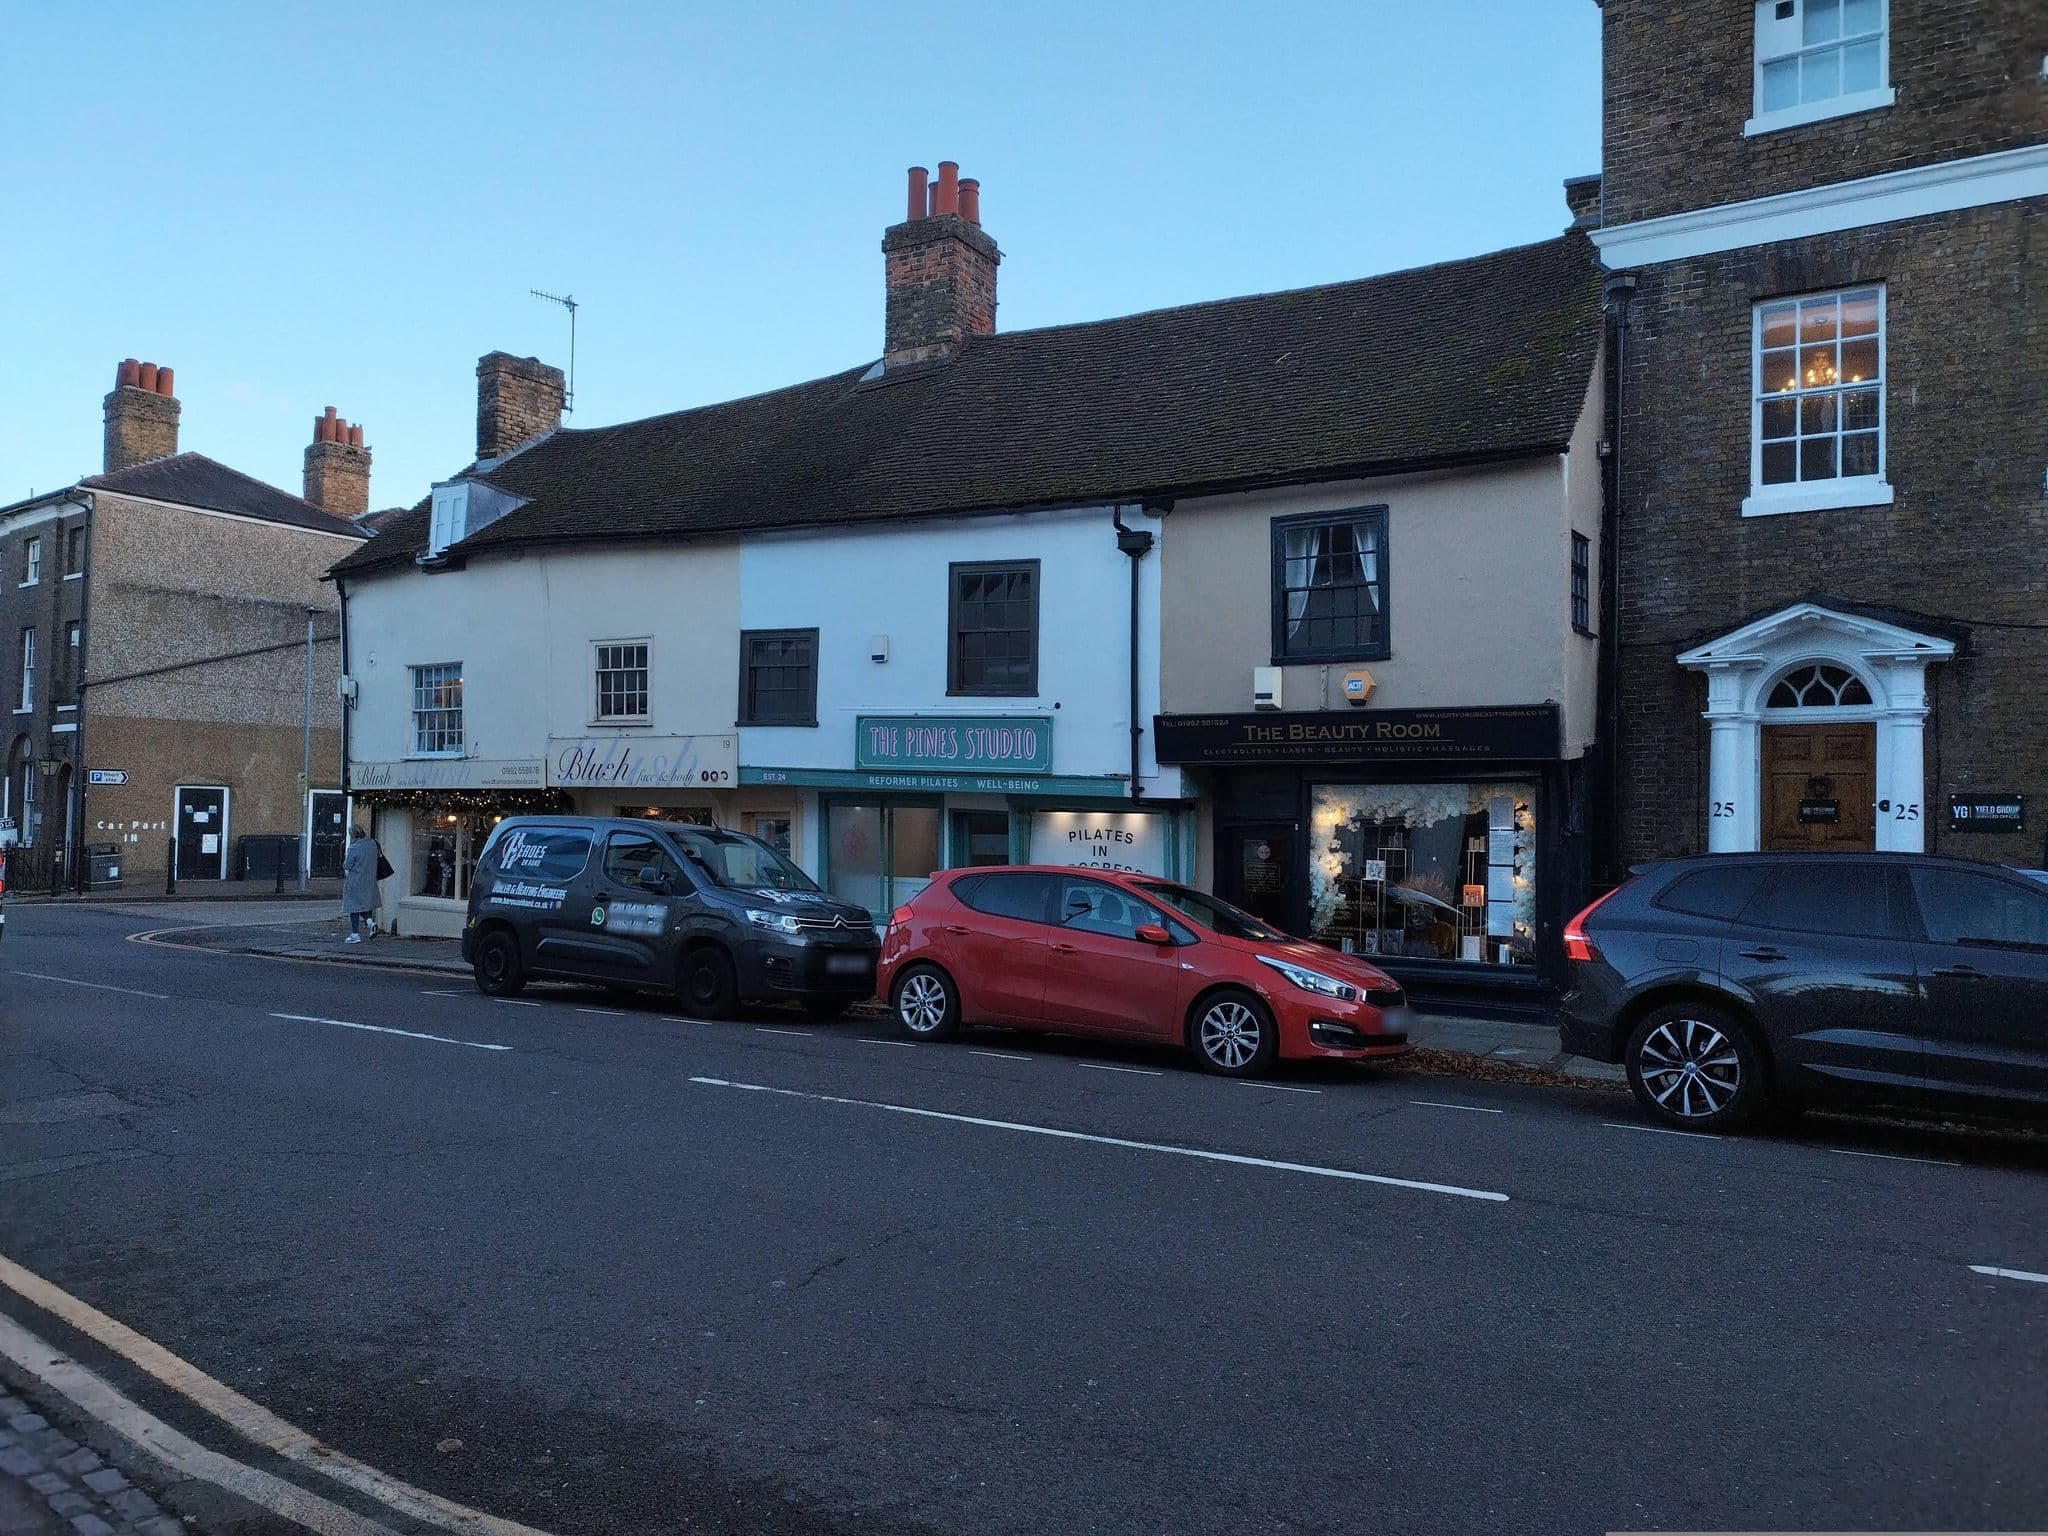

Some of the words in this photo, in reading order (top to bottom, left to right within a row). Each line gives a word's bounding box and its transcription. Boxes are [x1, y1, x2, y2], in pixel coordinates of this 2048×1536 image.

[1348, 681, 1362, 690] ADT
[1243, 725, 1284, 741] THE
[1290, 724, 1369, 740] BEAUTY
[1376, 722, 1441, 738] ROOM
[869, 727, 898, 757] THE
[905, 727, 958, 759] PINES
[965, 728, 1037, 760] STUDIO
[558, 747, 631, 781] Blush
[357, 764, 392, 786] Blush
[658, 770, 669, 782] &
[670, 768, 695, 786] body
[869, 776, 918, 787] REFORMER
[920, 778, 959, 788] PILATES
[1712, 801, 1735, 817] 25
[1895, 804, 1919, 820] 25
[1953, 805, 1969, 818] YG
[1975, 805, 1995, 813] YIELD
[97, 821, 123, 830] Car
[124, 833, 138, 842] IN
[1069, 829, 1134, 845] PILATES
[1092, 845, 1108, 857] IN
